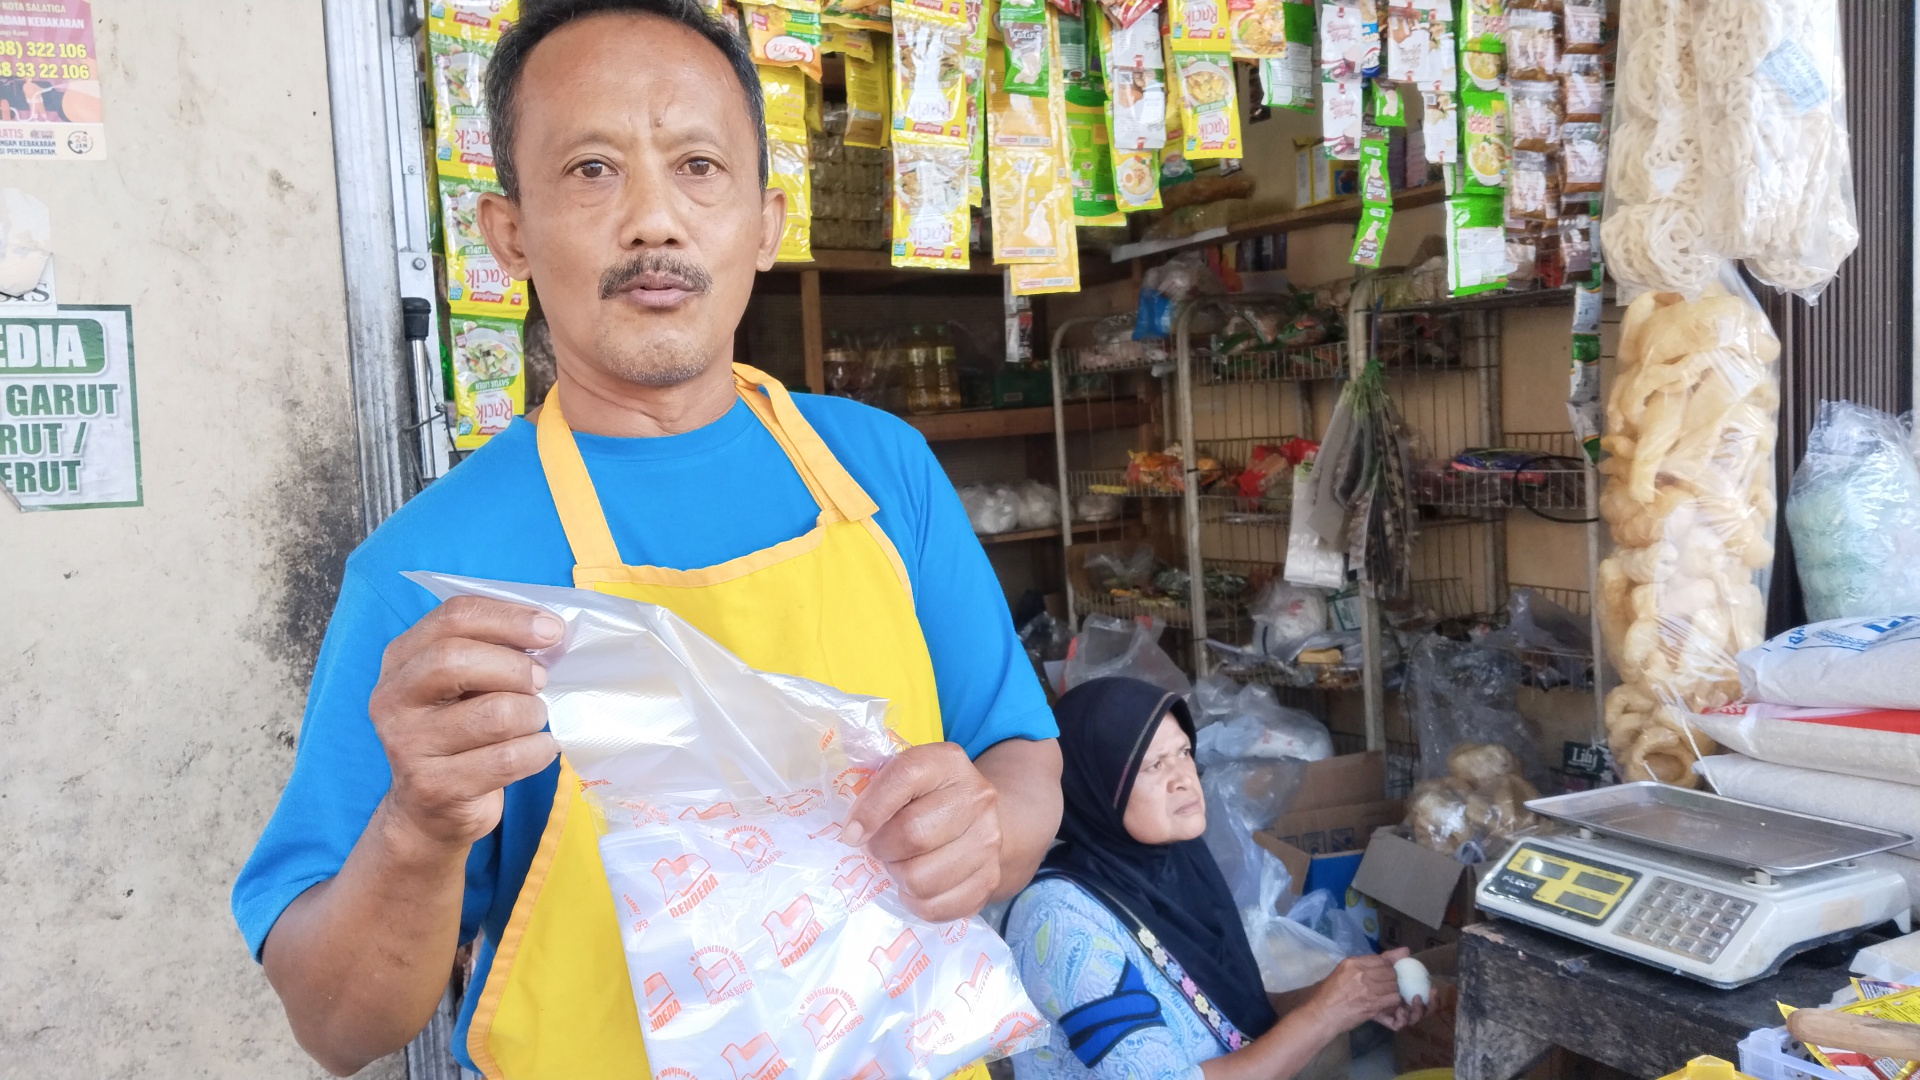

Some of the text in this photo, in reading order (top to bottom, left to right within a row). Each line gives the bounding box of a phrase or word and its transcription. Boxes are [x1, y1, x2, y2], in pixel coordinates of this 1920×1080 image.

[25, 3, 67, 13] SALATIGA
[1184, 5, 1218, 27] Racik
[27, 17, 84, 28] KEBAKARAN
[26, 41, 56, 57] 322
[58, 42, 87, 58] 106
[0, 61, 90, 79] 8 33 22 106
[0, 129, 24, 138] ATIS
[454, 129, 491, 150] acik
[1197, 118, 1231, 140] Racik
[465, 266, 511, 289] Racik
[0, 324, 87, 368] DIA
[6, 384, 118, 416] GARUT
[475, 399, 514, 425] Racik
[73, 422, 87, 454] /
[669, 873, 719, 919] BENDERA
[849, 878, 893, 915] KUALITAS SUPER
[781, 919, 825, 970] BENDERA
[694, 945, 729, 958] INDONESIAN
[728, 950, 747, 976] PRODUCT
[888, 953, 932, 1000] BENDERA
[709, 978, 755, 1007] KUALITAS SUPER
[804, 986, 840, 1005] INDONESIAN
[839, 989, 858, 1012] PRODUCT
[650, 998, 682, 1033] NDERA
[818, 1014, 865, 1054] KUALITAS SUPER
